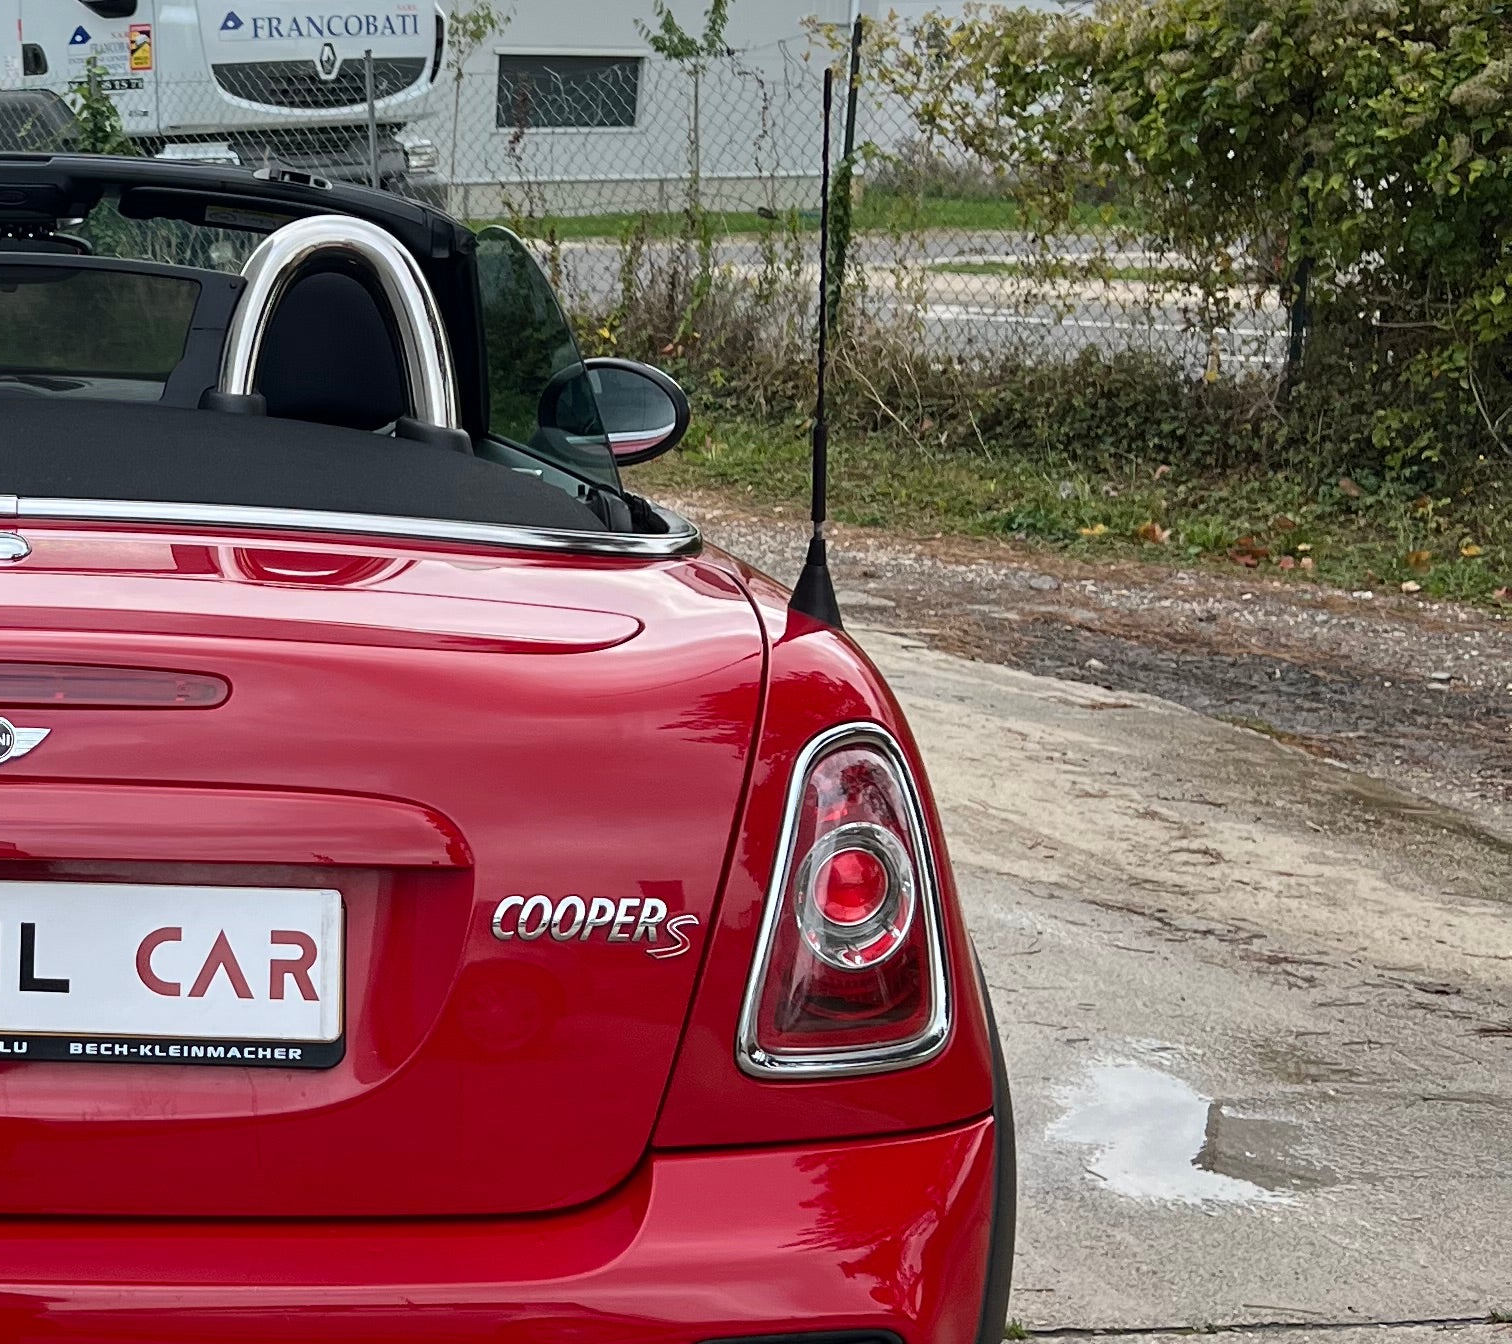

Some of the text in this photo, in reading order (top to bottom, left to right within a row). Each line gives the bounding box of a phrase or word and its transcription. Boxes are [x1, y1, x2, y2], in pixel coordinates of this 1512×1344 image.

[251, 13, 420, 39] FRANCOBATI
[491, 894, 700, 960] COOPER S
[135, 926, 320, 1002] CAR
[69, 1041, 303, 1061] BECH-KLEINMACHER
